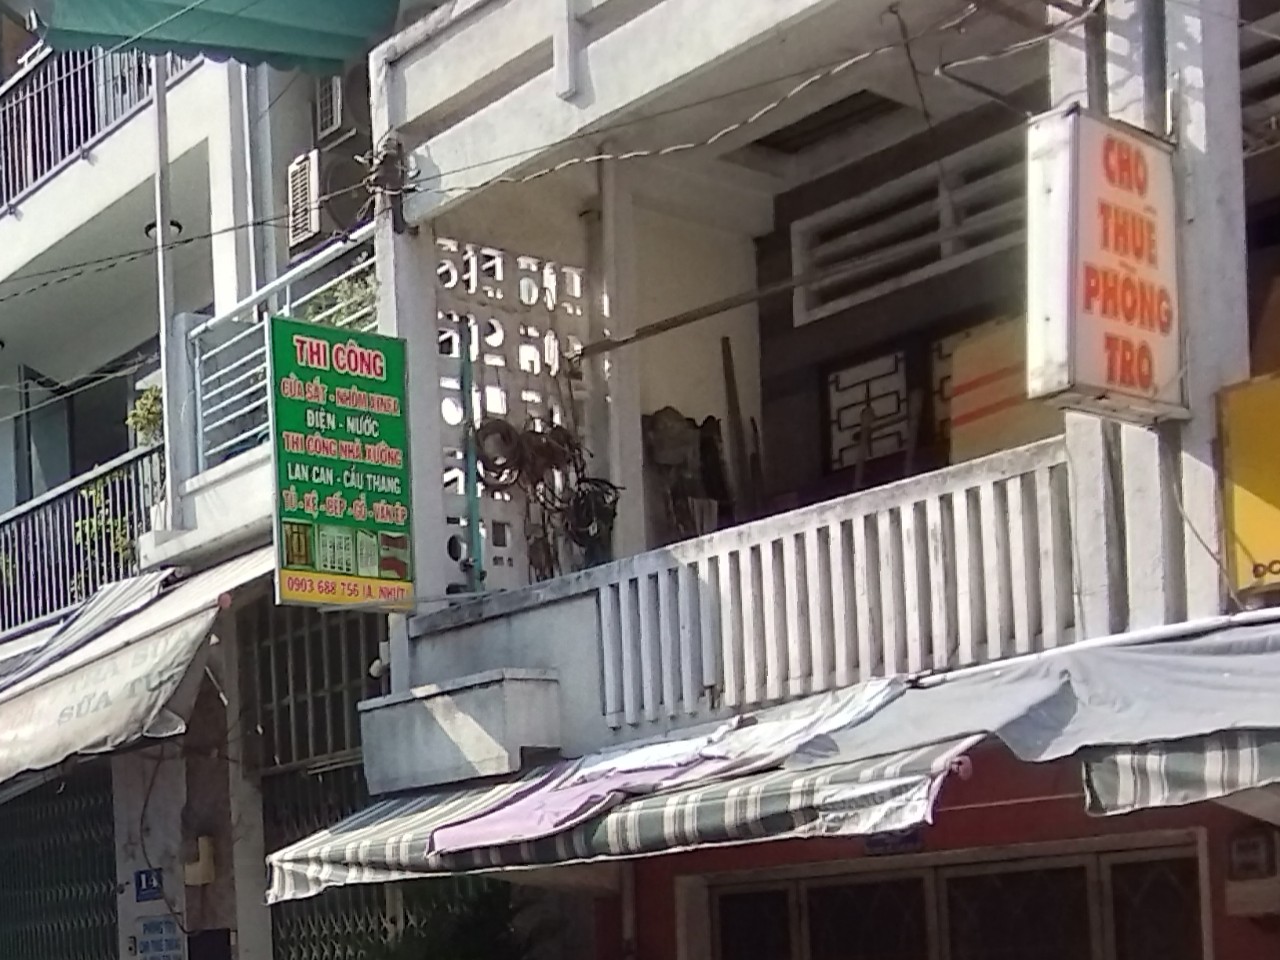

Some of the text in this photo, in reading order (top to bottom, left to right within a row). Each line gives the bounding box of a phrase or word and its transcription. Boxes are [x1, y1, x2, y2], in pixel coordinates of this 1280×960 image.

[1101, 133, 1148, 199] CHO
[1098, 201, 1158, 269] THUÊ
[1083, 260, 1173, 336] PHÒNG
[293, 335, 386, 381] THI CÔNG
[305, 376, 327, 404] SẮT
[307, 408, 379, 437] ĐIỆN NƯỚC
[283, 431, 304, 453] THI
[306, 432, 337, 459] CÔNG
[288, 462, 308, 481] LAN
[312, 466, 333, 486] CAN
[366, 474, 401, 494] THANG
[287, 576, 314, 593] 0903
[317, 580, 336, 596] 688
